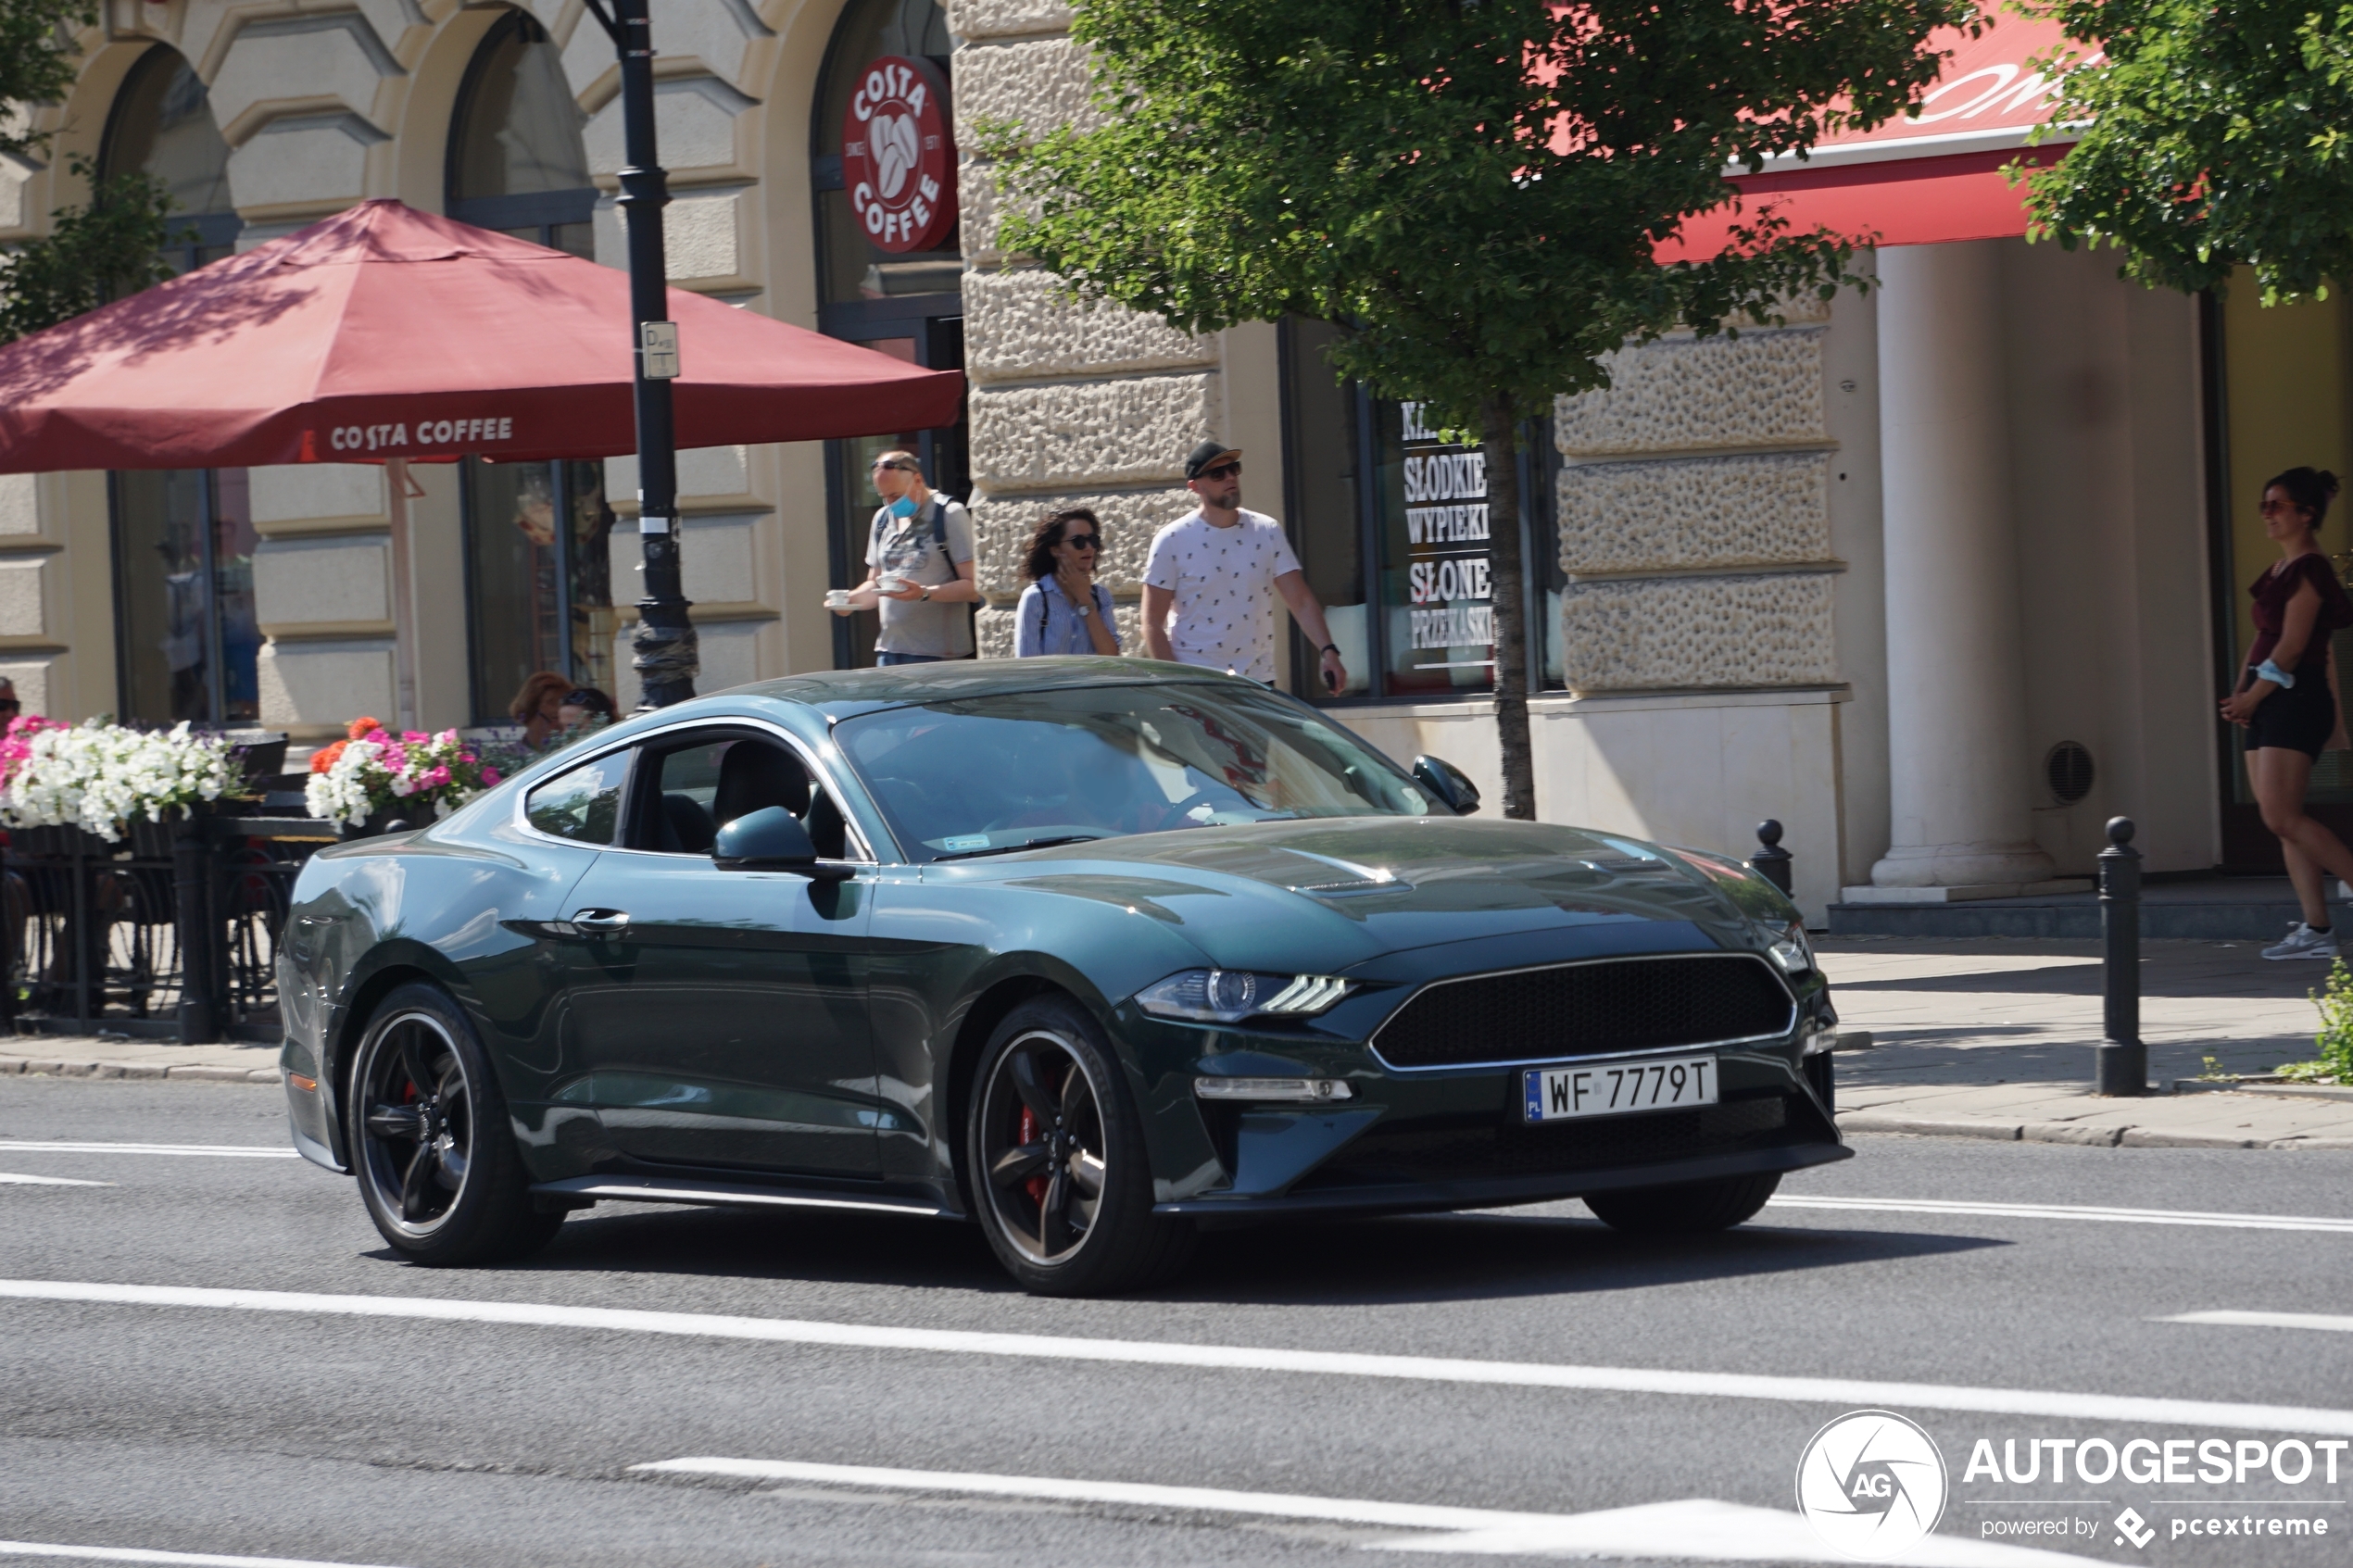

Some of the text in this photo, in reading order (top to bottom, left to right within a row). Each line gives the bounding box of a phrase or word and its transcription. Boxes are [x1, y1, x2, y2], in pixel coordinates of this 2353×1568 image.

[853, 64, 926, 121] COSTA
[853, 174, 940, 243] COFFEE
[331, 417, 513, 451] COSTA COFFEE
[1403, 452, 1488, 502] SŁODKIE
[1405, 503, 1491, 544] WYPIEKI
[1410, 558, 1491, 602] SŁONE
[1529, 1102, 1541, 1113] PL
[1550, 1062, 1708, 1113] WF 7779T
